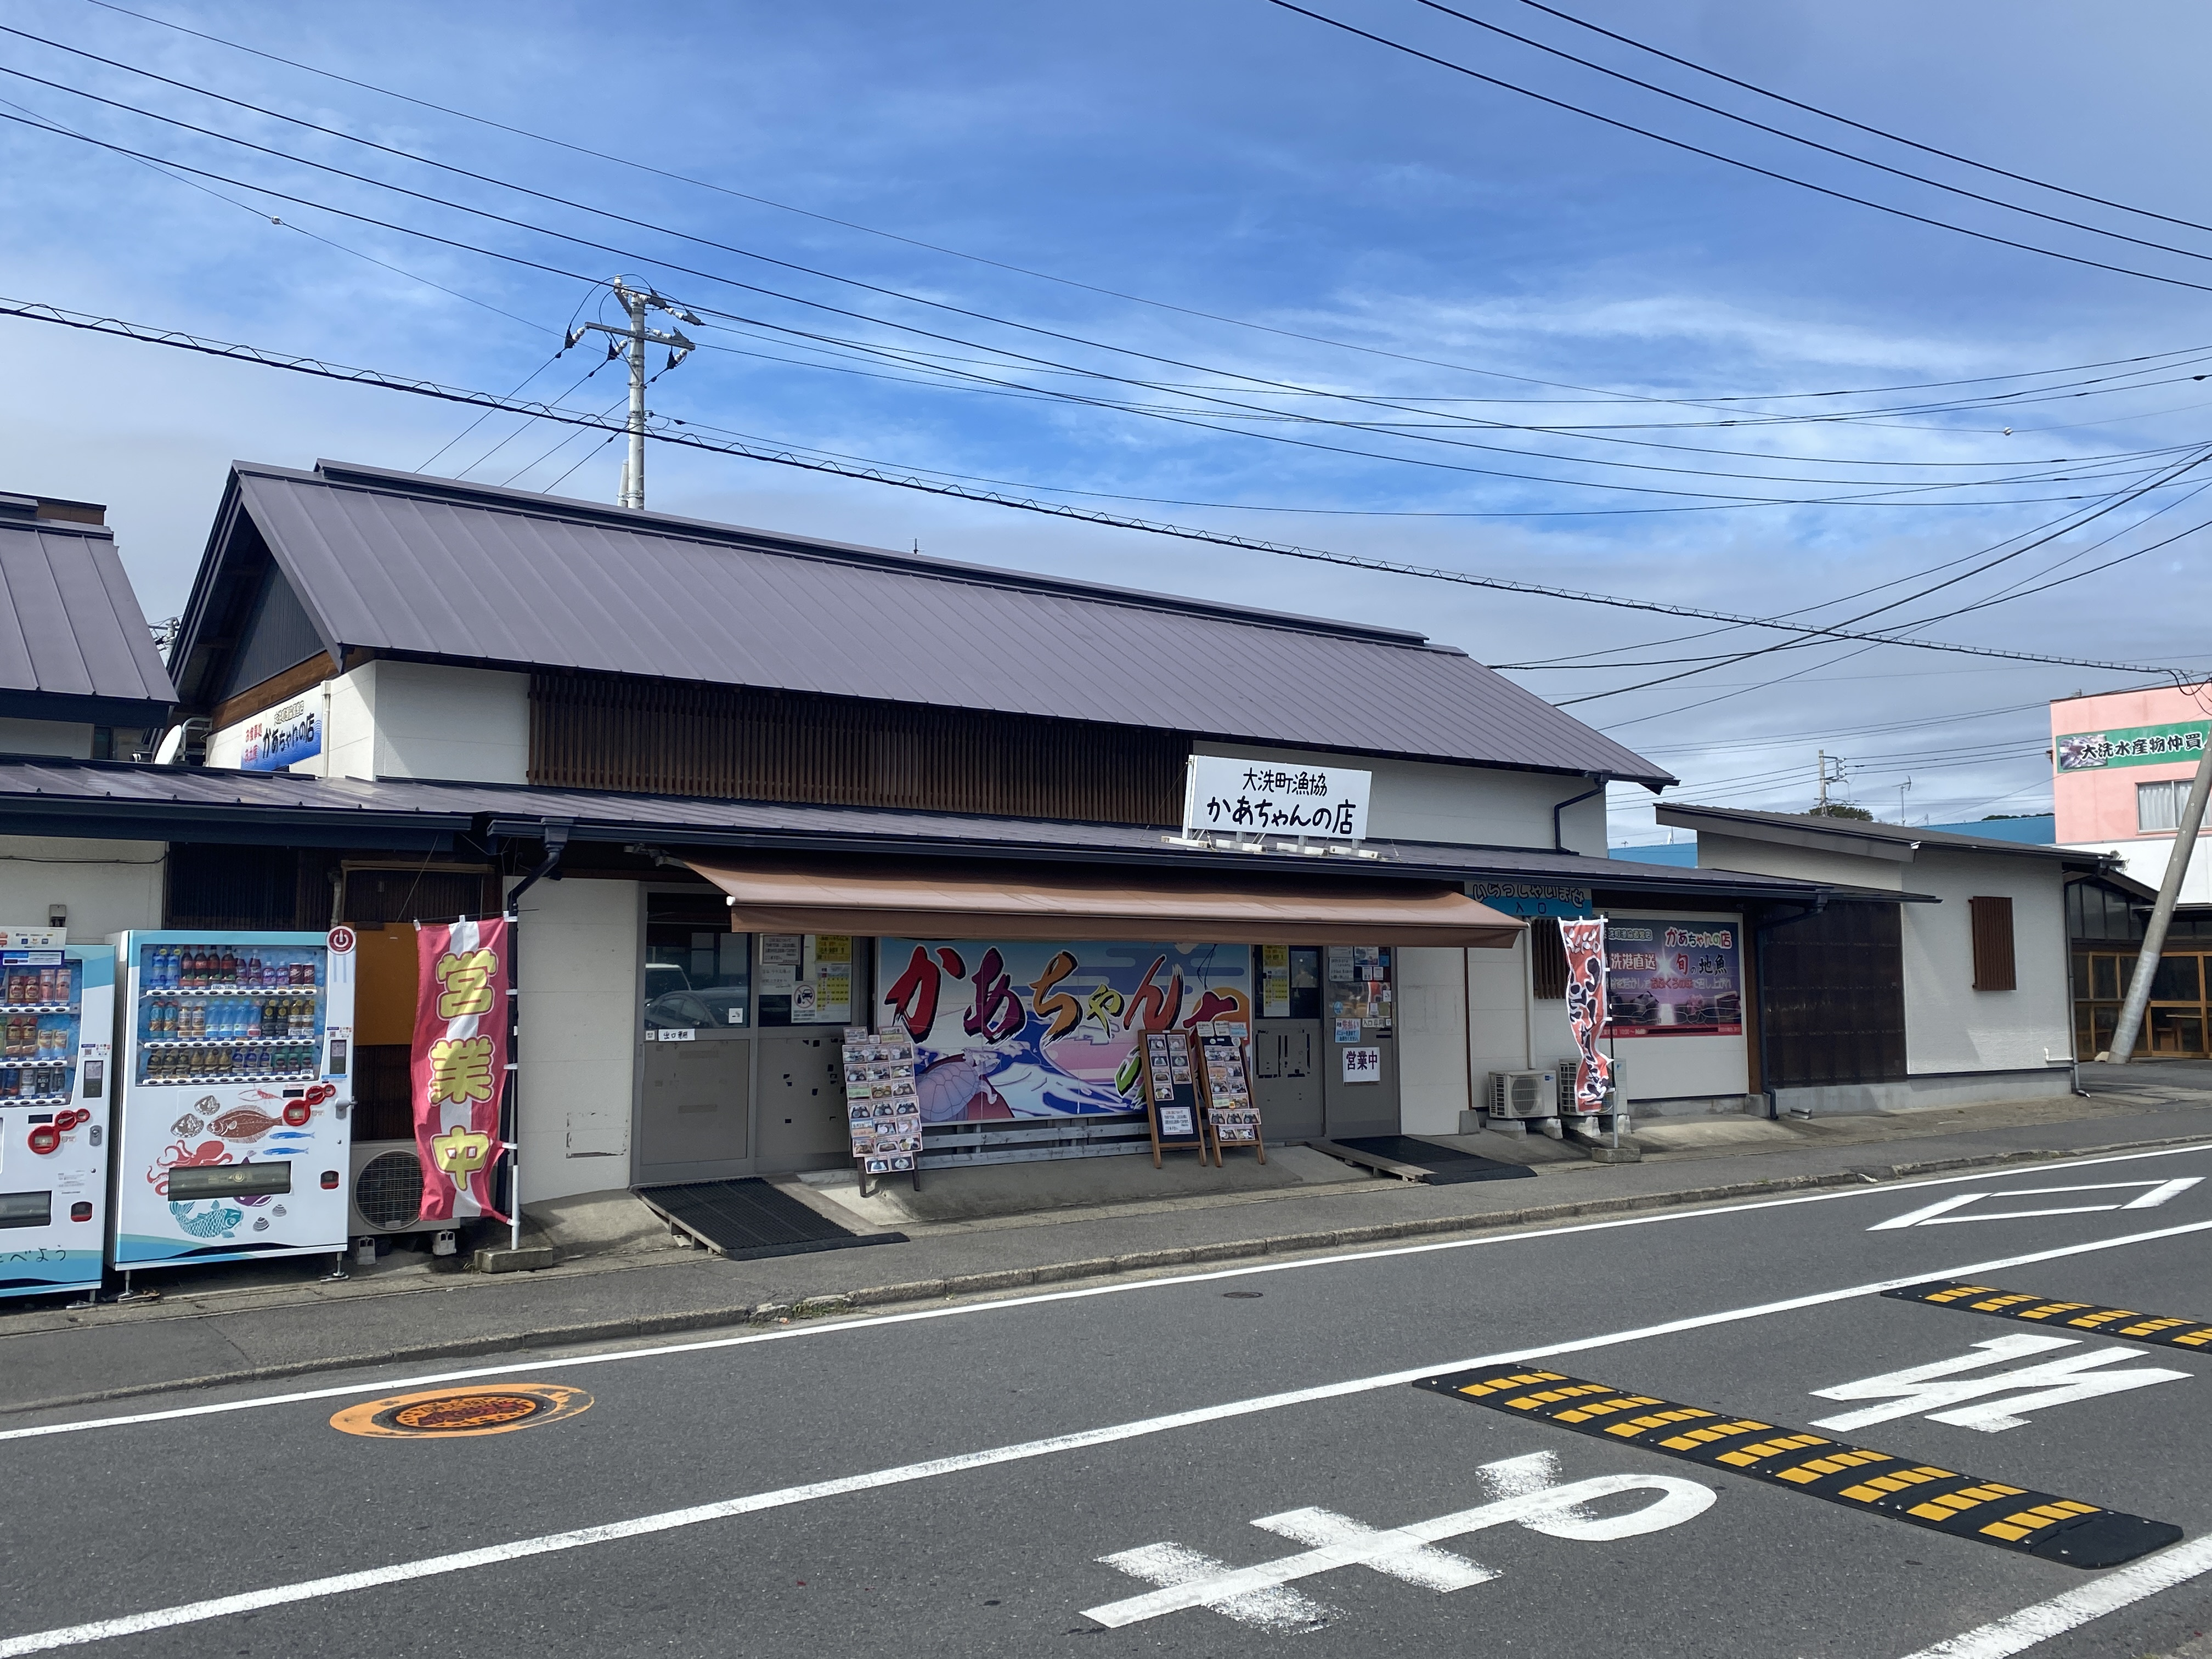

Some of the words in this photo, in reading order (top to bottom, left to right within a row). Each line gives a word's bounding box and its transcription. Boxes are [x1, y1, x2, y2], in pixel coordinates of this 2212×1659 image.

[262, 713, 314, 759] かあちゃんの店
[2082, 732, 2206, 760] 大洗水産物仲買
[1243, 767, 1328, 797] 大洗町漁協
[1207, 795, 1356, 834] かあちゃんの店
[1472, 883, 1585, 909] いらっしゃいませ
[1516, 901, 1547, 915] 入口
[1665, 927, 1732, 949] かあちゃんの店
[1605, 953, 1657, 971] 洗港直送
[884, 944, 1184, 1043] かあちゃん
[428, 948, 498, 1191] 営業中
[1346, 1051, 1378, 1070] 営業中
[0, 1245, 66, 1262] べよう
